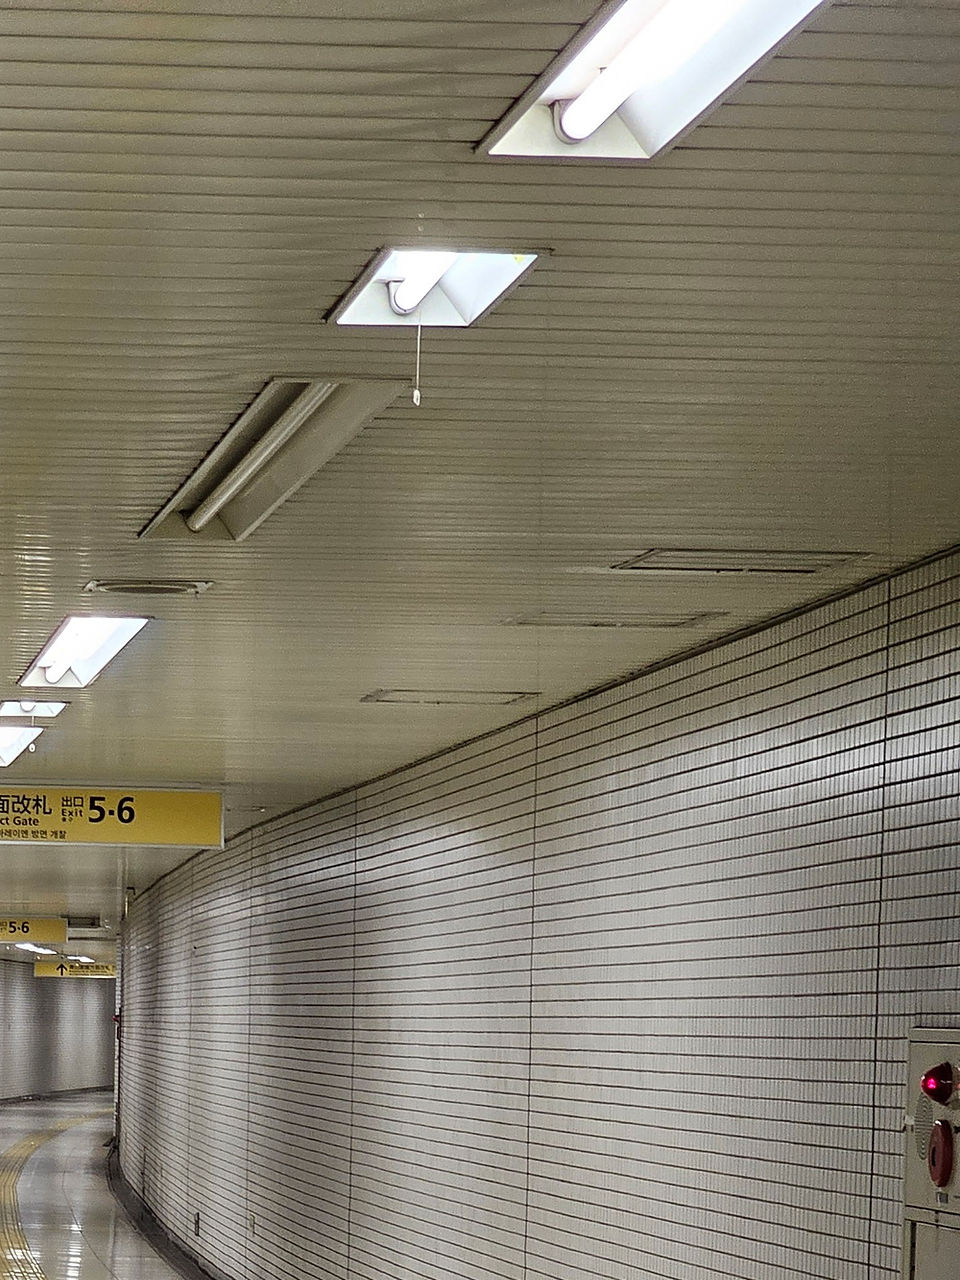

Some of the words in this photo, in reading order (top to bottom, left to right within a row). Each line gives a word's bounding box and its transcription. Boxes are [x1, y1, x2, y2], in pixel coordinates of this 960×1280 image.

[61, 796, 84, 808] 出口
[61, 808, 83, 818] Exit
[13, 816, 40, 826] Gate
